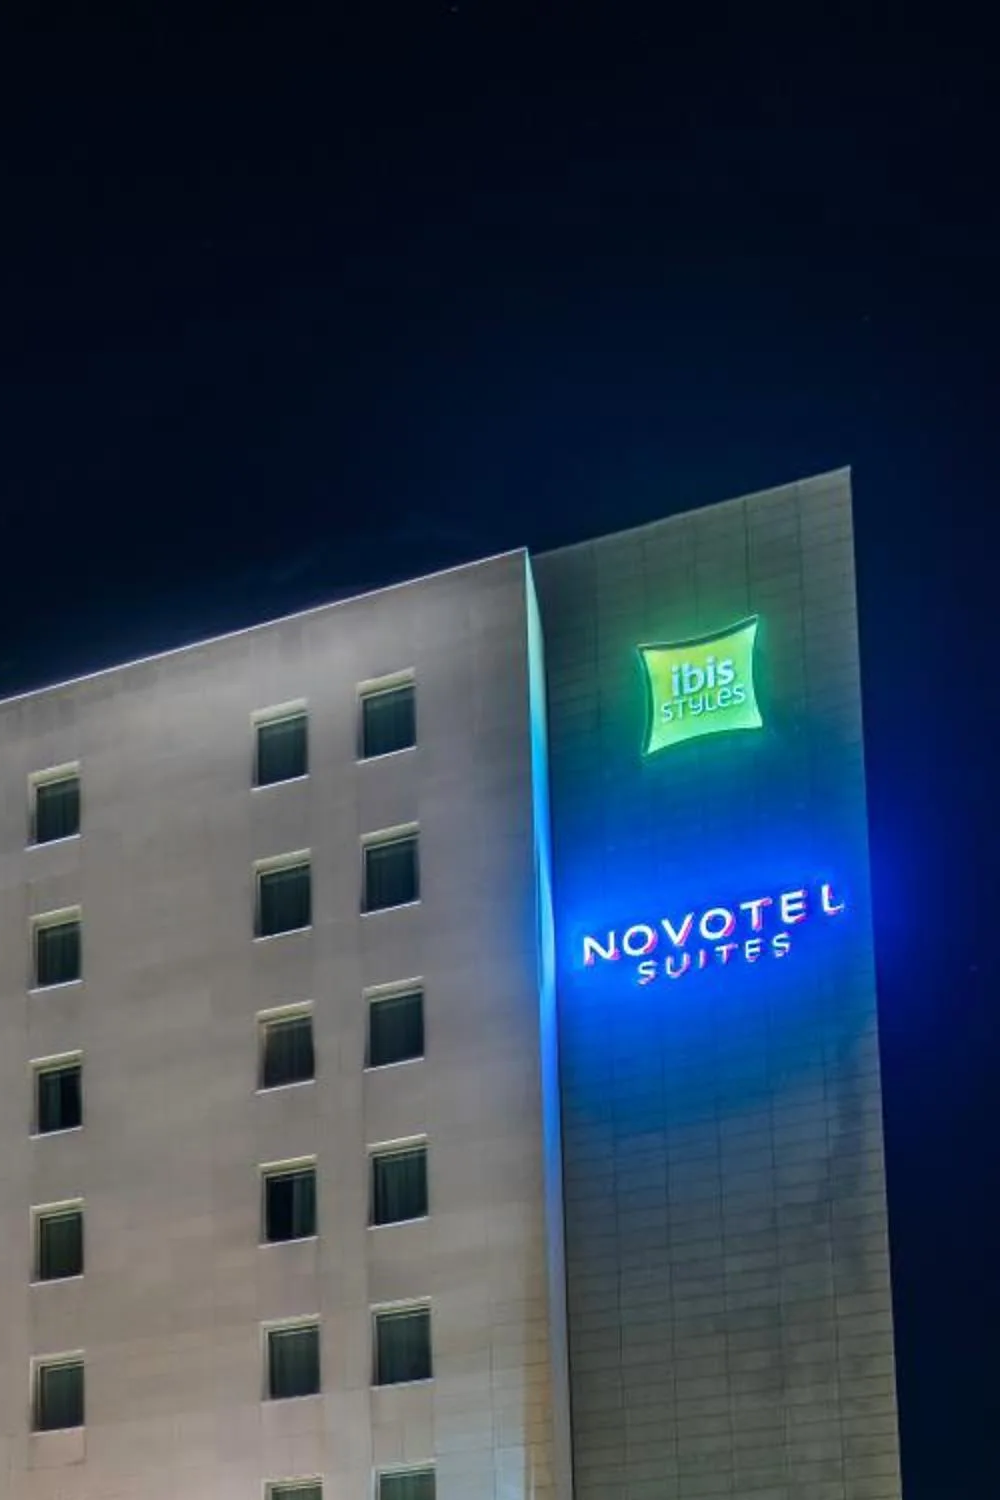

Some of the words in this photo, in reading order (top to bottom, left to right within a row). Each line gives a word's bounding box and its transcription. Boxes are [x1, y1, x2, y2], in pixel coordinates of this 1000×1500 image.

[671, 656, 735, 697] ibis
[583, 884, 845, 965] NOVOTEL
[637, 933, 792, 985] SUITES
